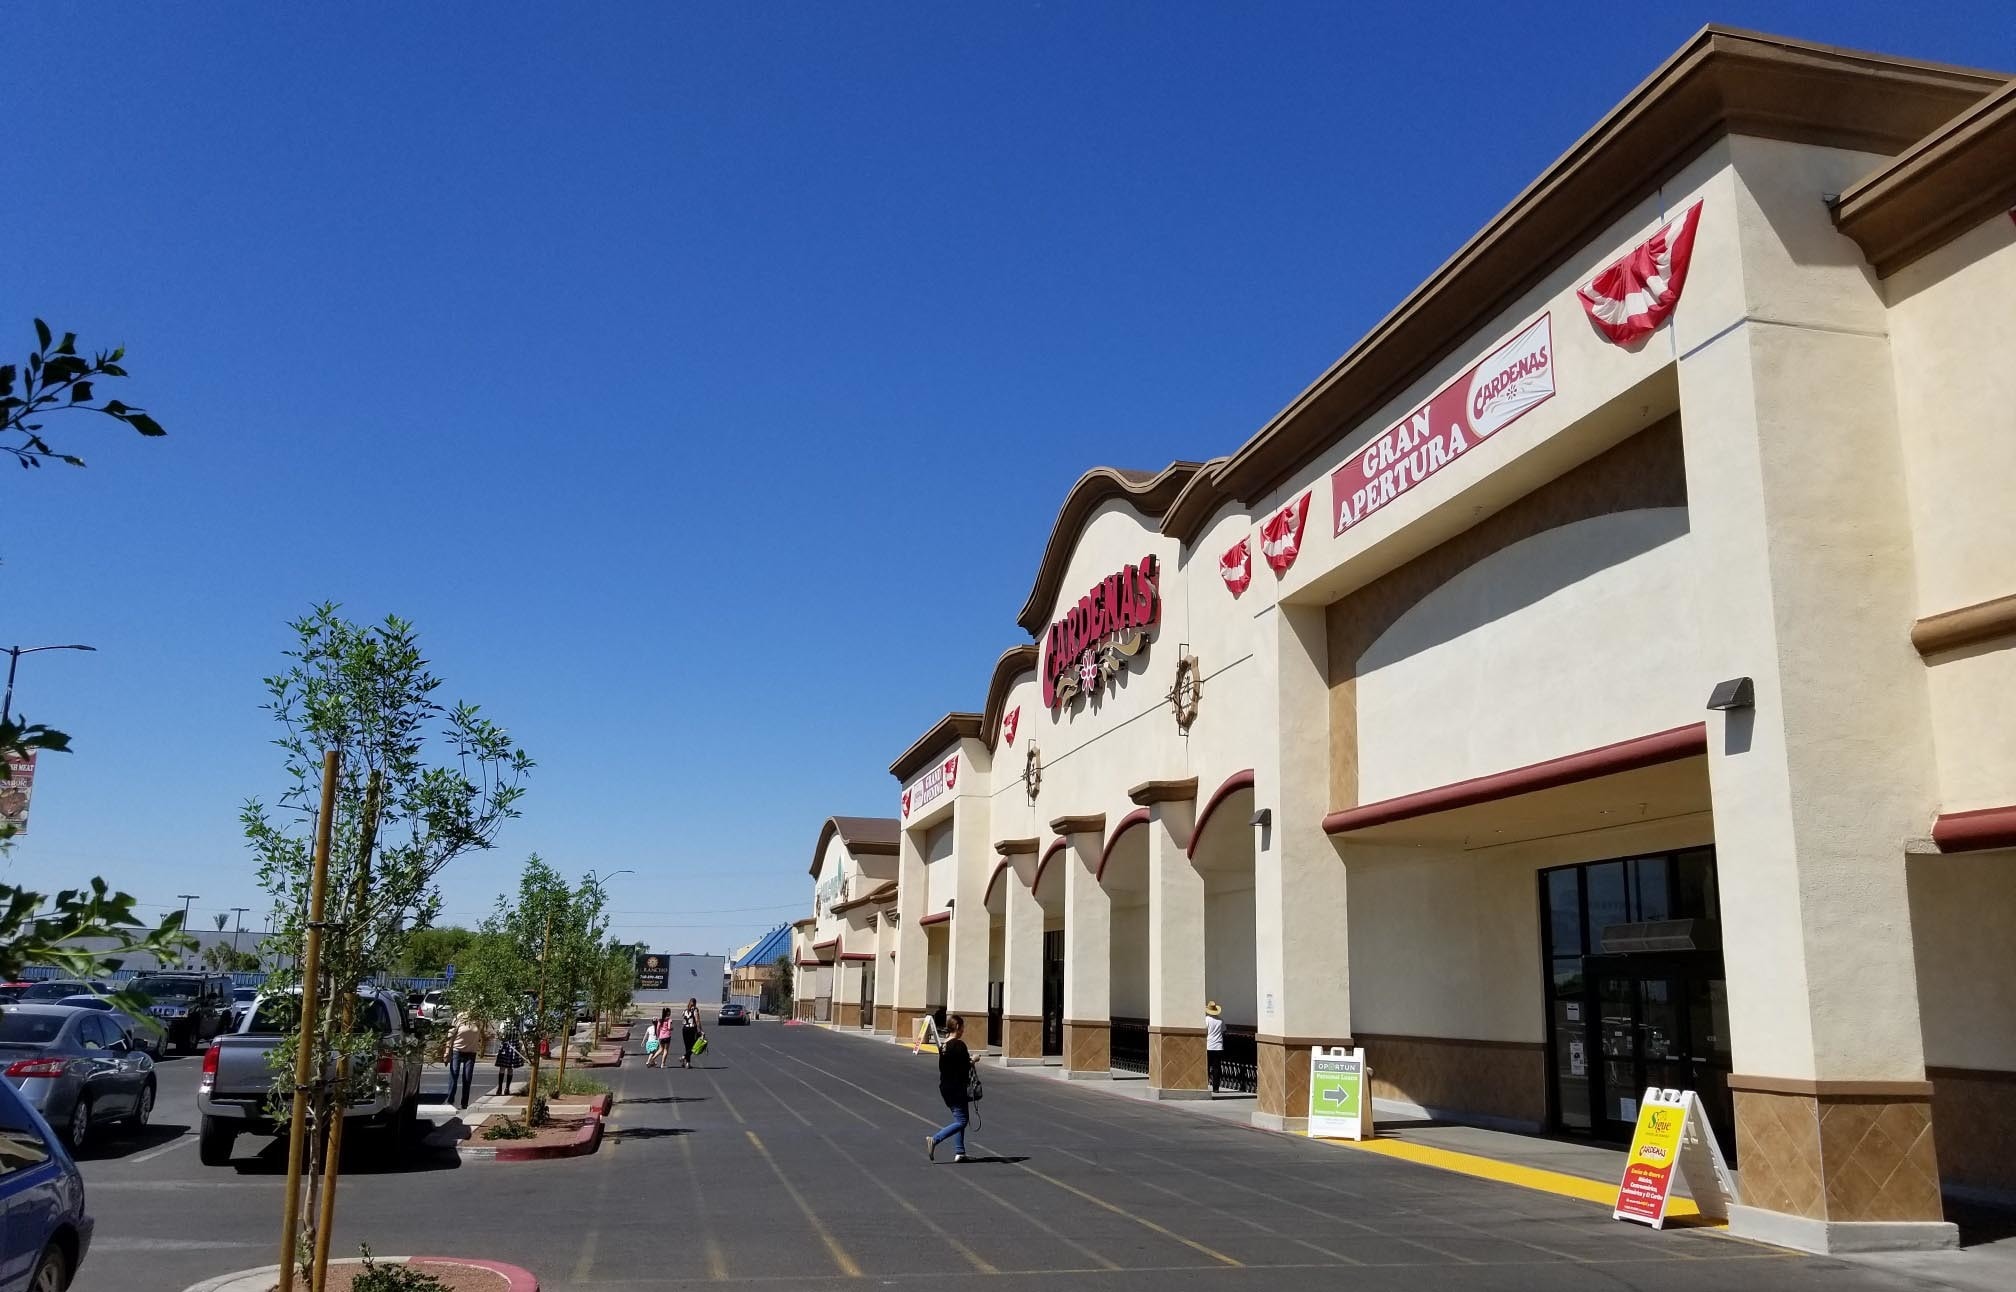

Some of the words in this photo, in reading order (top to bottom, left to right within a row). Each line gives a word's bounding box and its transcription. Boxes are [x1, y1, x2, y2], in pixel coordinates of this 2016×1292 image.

[1473, 345, 1548, 420] CARDENAS
[1337, 423, 1468, 533] APERTURA
[1362, 405, 1431, 479] GRAN
[1043, 554, 1157, 709] CARDENAS
[1639, 1145, 1667, 1158] CARDENAS
[1648, 1111, 1672, 1133] Sigue
